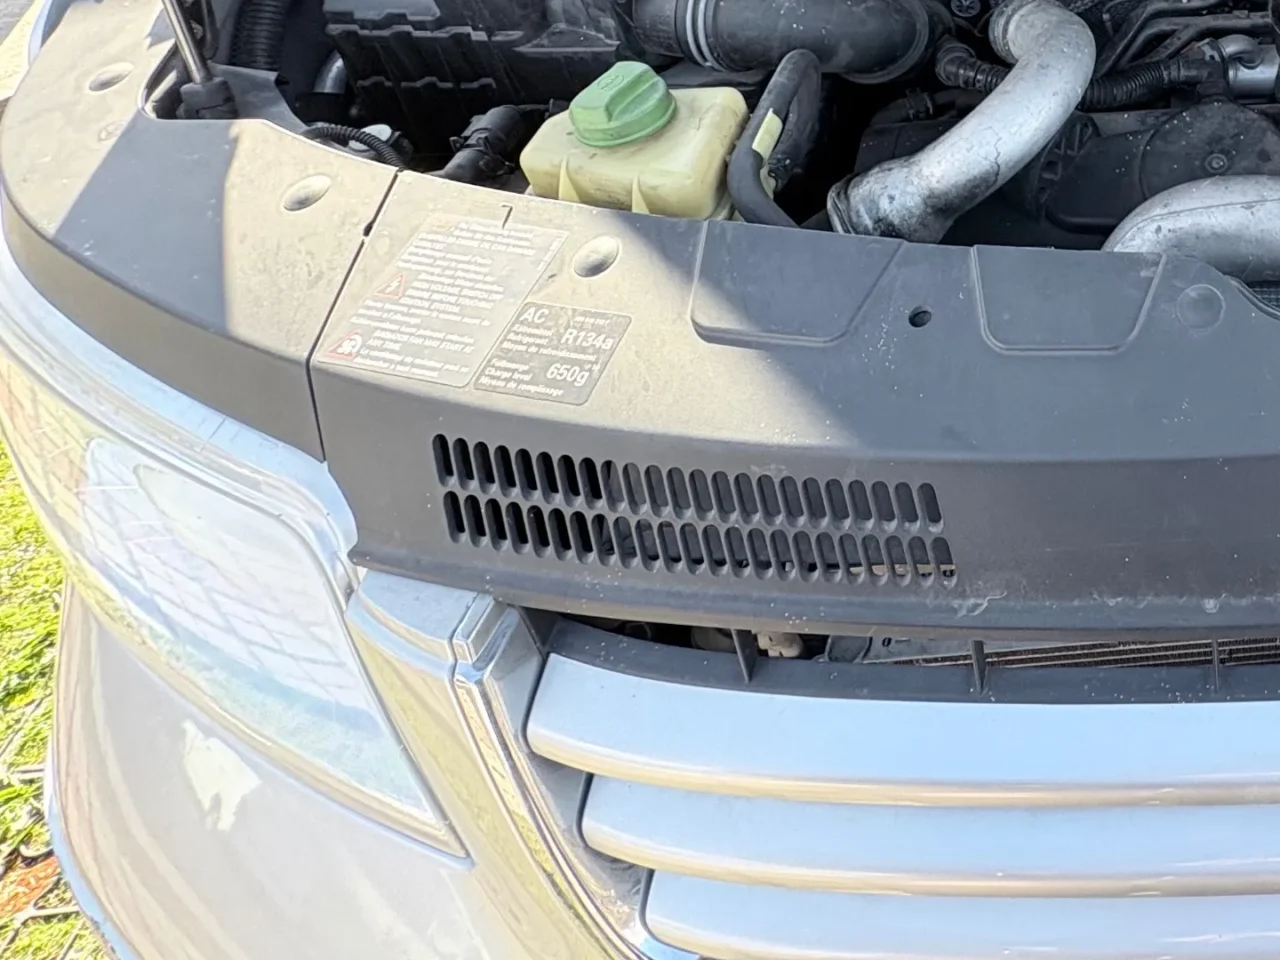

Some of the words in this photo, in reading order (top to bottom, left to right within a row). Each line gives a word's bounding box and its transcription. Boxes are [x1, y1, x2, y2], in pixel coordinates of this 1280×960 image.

[519, 307, 549, 323] AC
[561, 328, 614, 349] R134a
[546, 363, 590, 386] 650g
